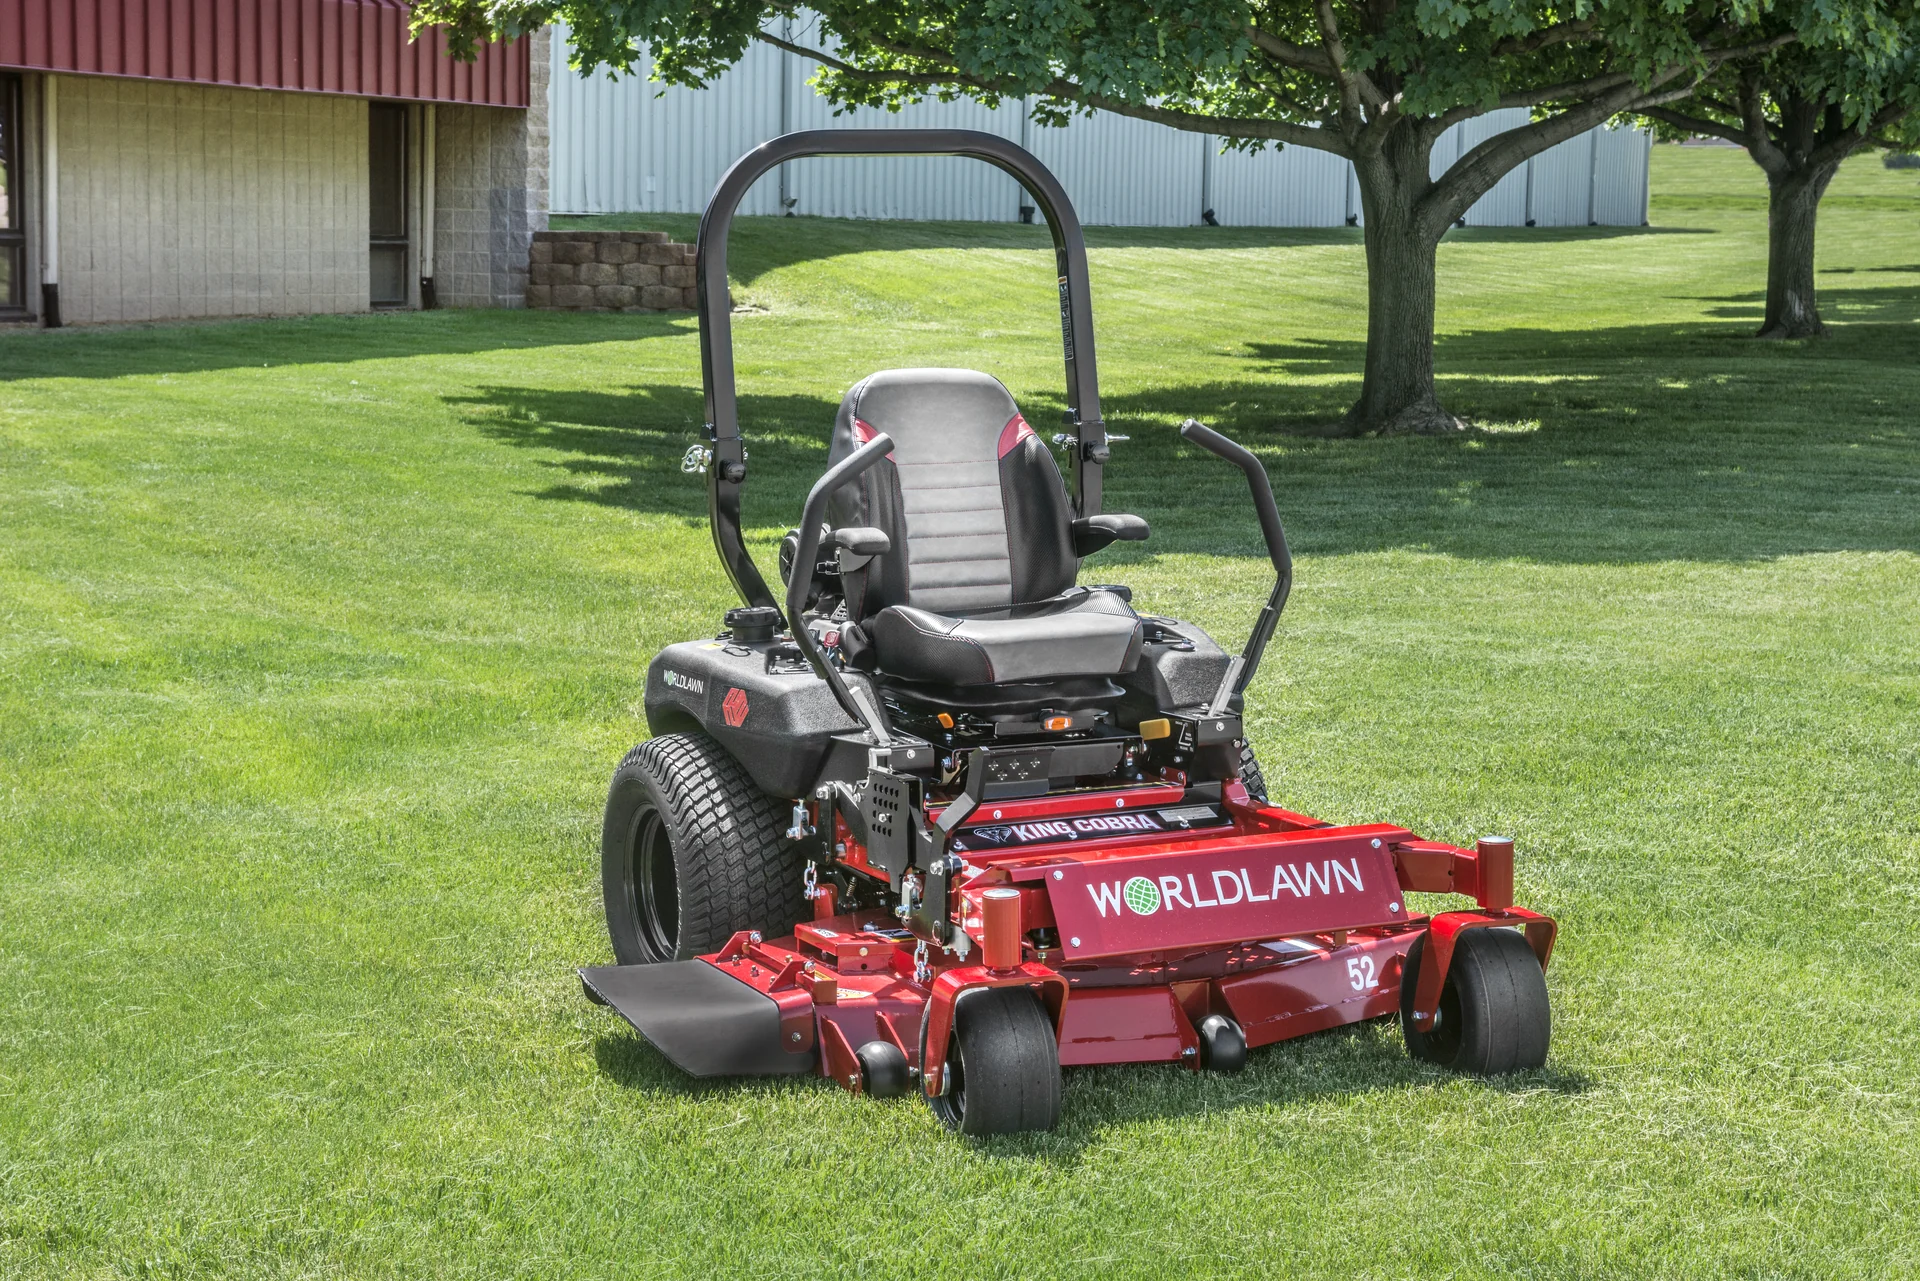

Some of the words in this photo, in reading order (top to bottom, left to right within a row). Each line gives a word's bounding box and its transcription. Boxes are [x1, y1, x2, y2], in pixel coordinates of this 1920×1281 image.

[663, 669, 704, 694] WORLDLAWN
[1010, 821, 1071, 842] KING
[1073, 813, 1162, 833] COBRA
[1086, 858, 1364, 918] WORLDLAWN
[1347, 955, 1379, 991] 52
